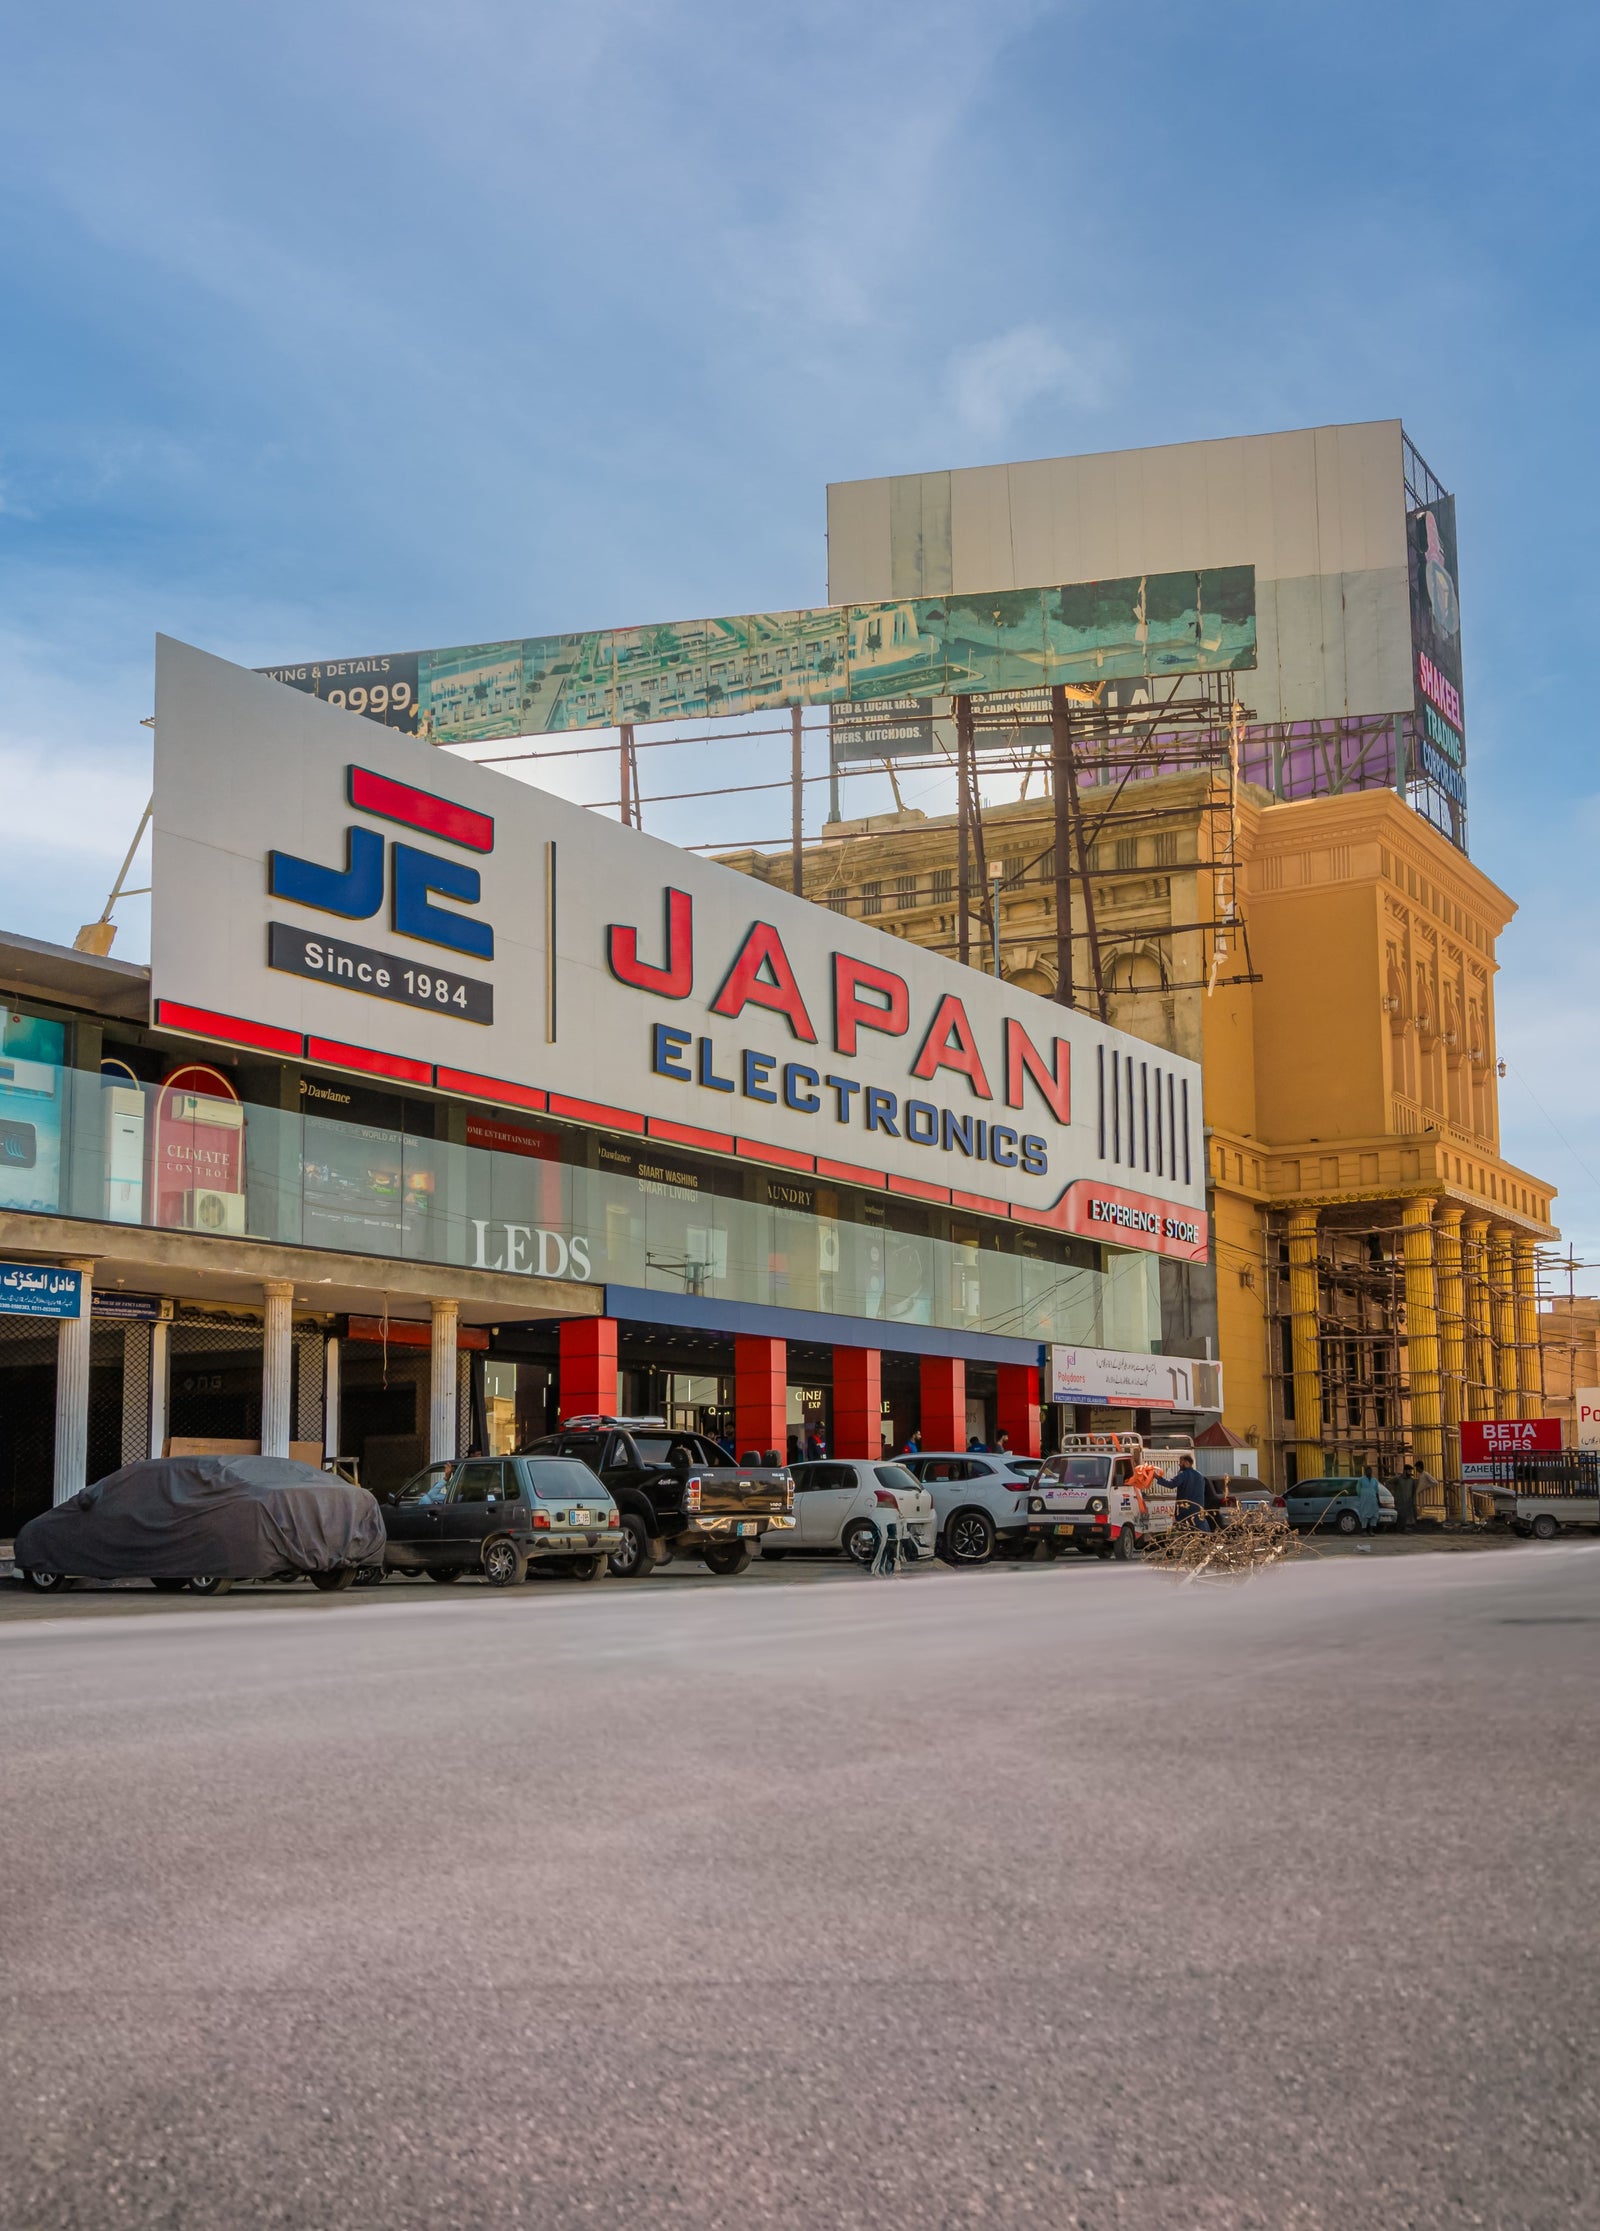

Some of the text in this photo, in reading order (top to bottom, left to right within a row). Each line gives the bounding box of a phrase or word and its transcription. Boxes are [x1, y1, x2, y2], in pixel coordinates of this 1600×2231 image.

[263, 658, 390, 682] KING & DETAILS
[1419, 651, 1463, 732] SHAKEEL
[1424, 704, 1462, 767] TRADING
[1422, 739, 1467, 810] CORPORATION
[304, 942, 469, 1009] Since 1984
[607, 886, 1071, 1126] JAPAN
[308, 1084, 351, 1104] Dawlance
[653, 1022, 1048, 1176] ELECTRONICS
[361, 1128, 388, 1141] WORLD
[389, 1135, 397, 1143] AT
[484, 1129, 541, 1148] ENTERTAINMENT
[167, 1144, 231, 1167] CLIMATE
[166, 1162, 231, 1181] CONTROL
[638, 1163, 698, 1188] SMART WASHING
[638, 1179, 667, 1197] SMART
[1091, 1199, 1200, 1244] EXPERIENCE STORE
[471, 1220, 592, 1281] LEDS
[50, 1275, 76, 1294] عادل
[1058, 1371, 1086, 1385] Polydoors
[1483, 1423, 1537, 1439] BETA
[1488, 1439, 1532, 1452] PIPES
